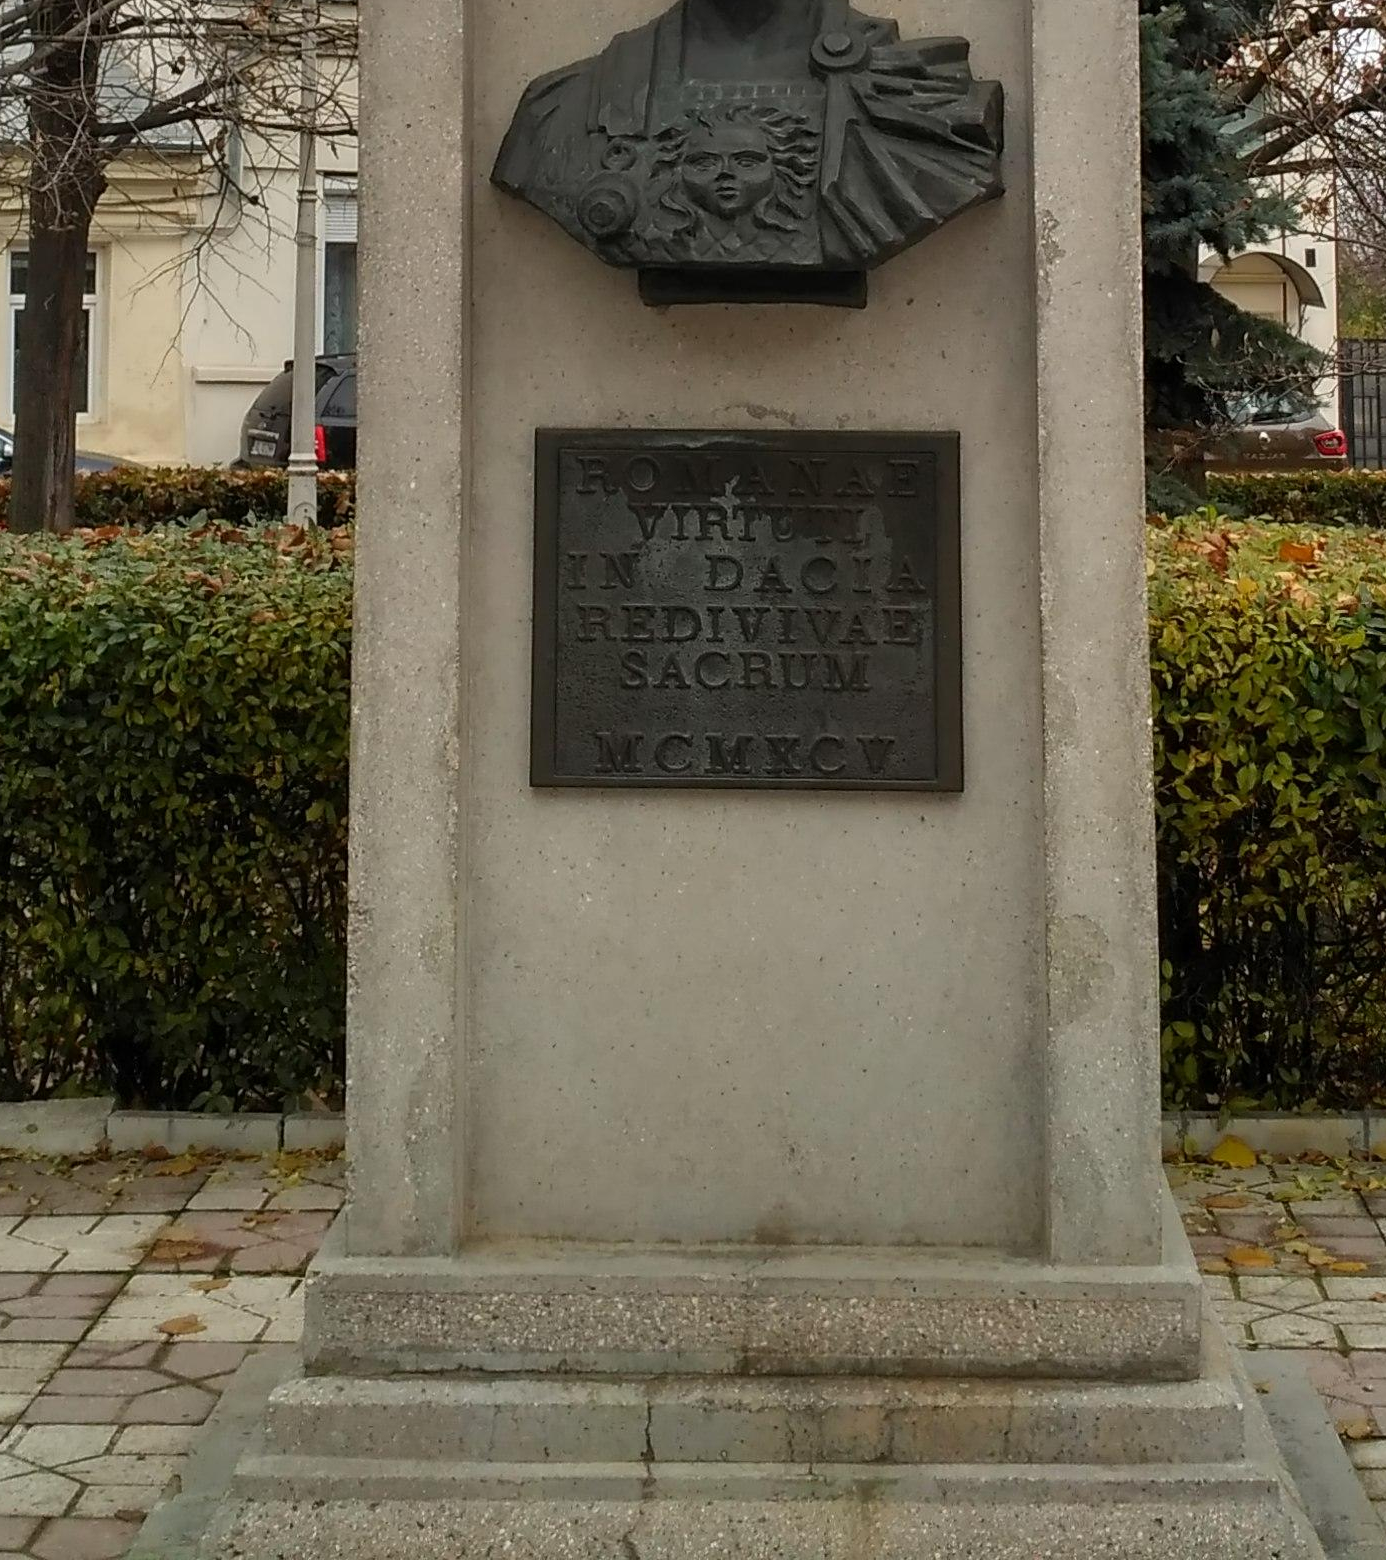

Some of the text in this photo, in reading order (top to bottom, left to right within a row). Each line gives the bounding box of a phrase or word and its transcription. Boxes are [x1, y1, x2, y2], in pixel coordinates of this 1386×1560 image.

[576, 455, 919, 498] ROMANAE
[629, 503, 867, 543] VIRTUTI
[566, 551, 927, 594] IN DACIA
[576, 604, 922, 646] REDIVIVAE
[620, 650, 873, 692] SACRUM
[593, 731, 895, 774] MCMXCV
